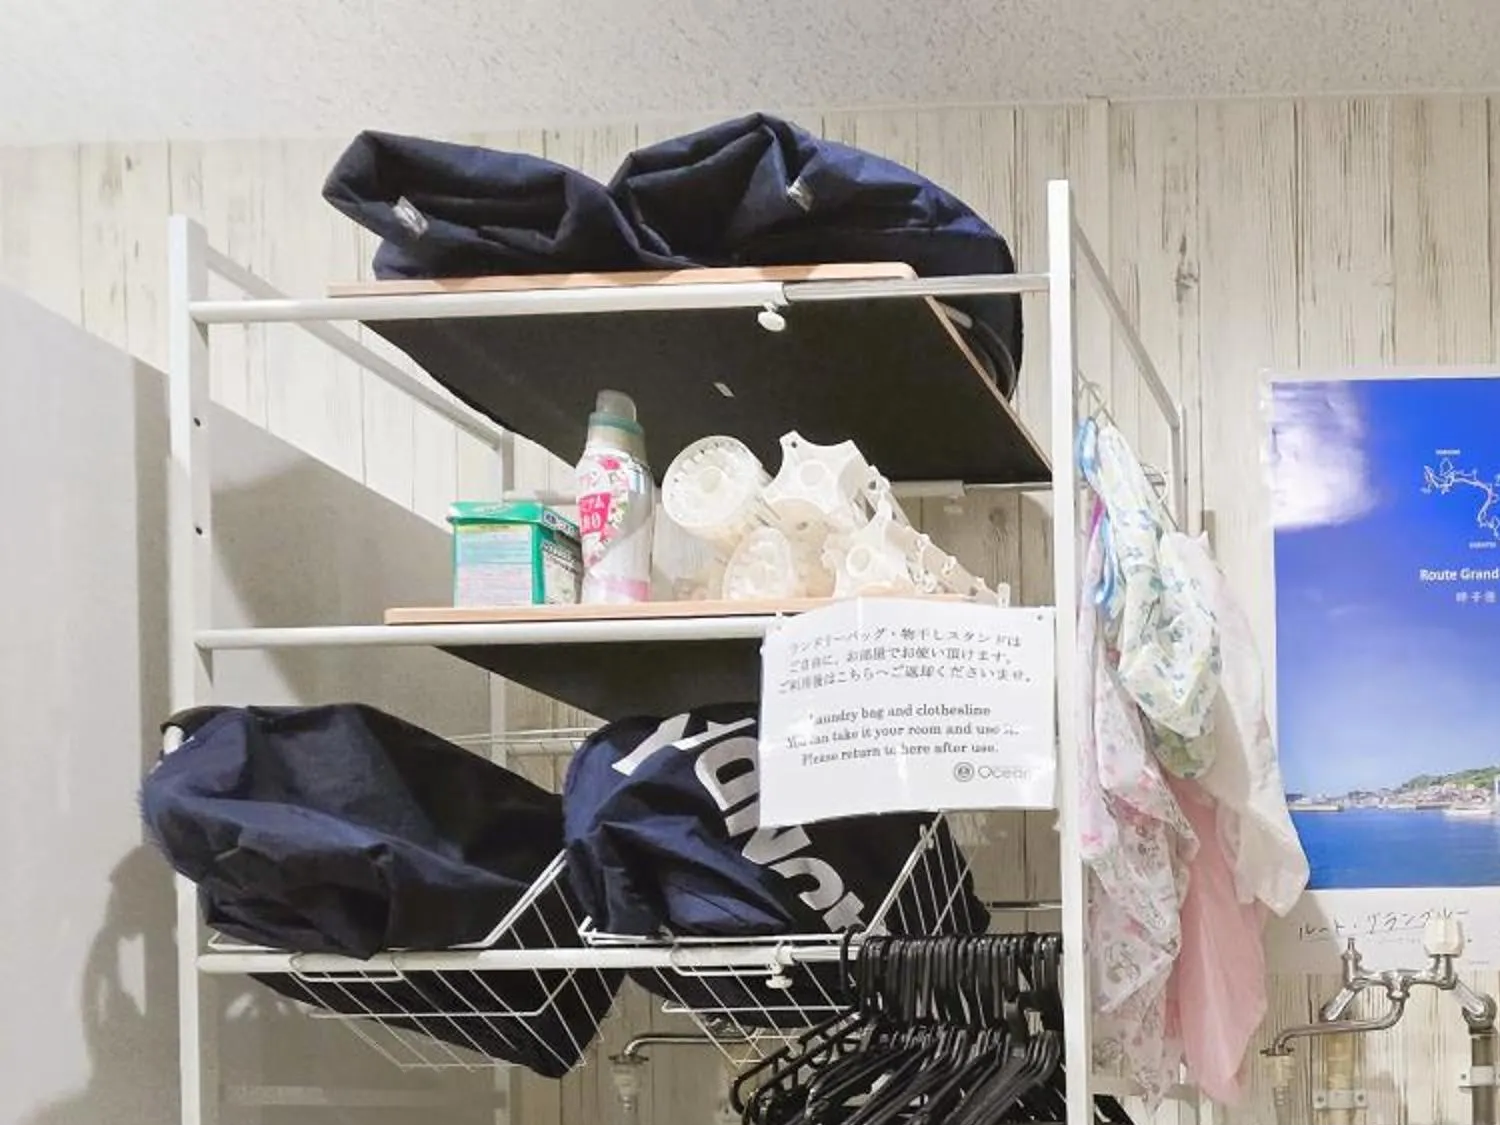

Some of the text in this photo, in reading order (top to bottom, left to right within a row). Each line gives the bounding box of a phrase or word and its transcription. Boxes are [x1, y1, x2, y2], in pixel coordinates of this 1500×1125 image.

[1420, 569, 1457, 581] Route
[1460, 567, 1499, 580] Grand
[809, 710, 858, 727] aundry
[861, 706, 884, 720] bag
[887, 704, 913, 717] and
[832, 729, 858, 742] take
[862, 727, 873, 738] it
[875, 726, 904, 740] your
[908, 725, 941, 736] room
[947, 723, 972, 736] and
[977, 724, 1000, 736] use
[802, 751, 839, 767] Please
[841, 746, 881, 761] return
[934, 741, 966, 755] after
